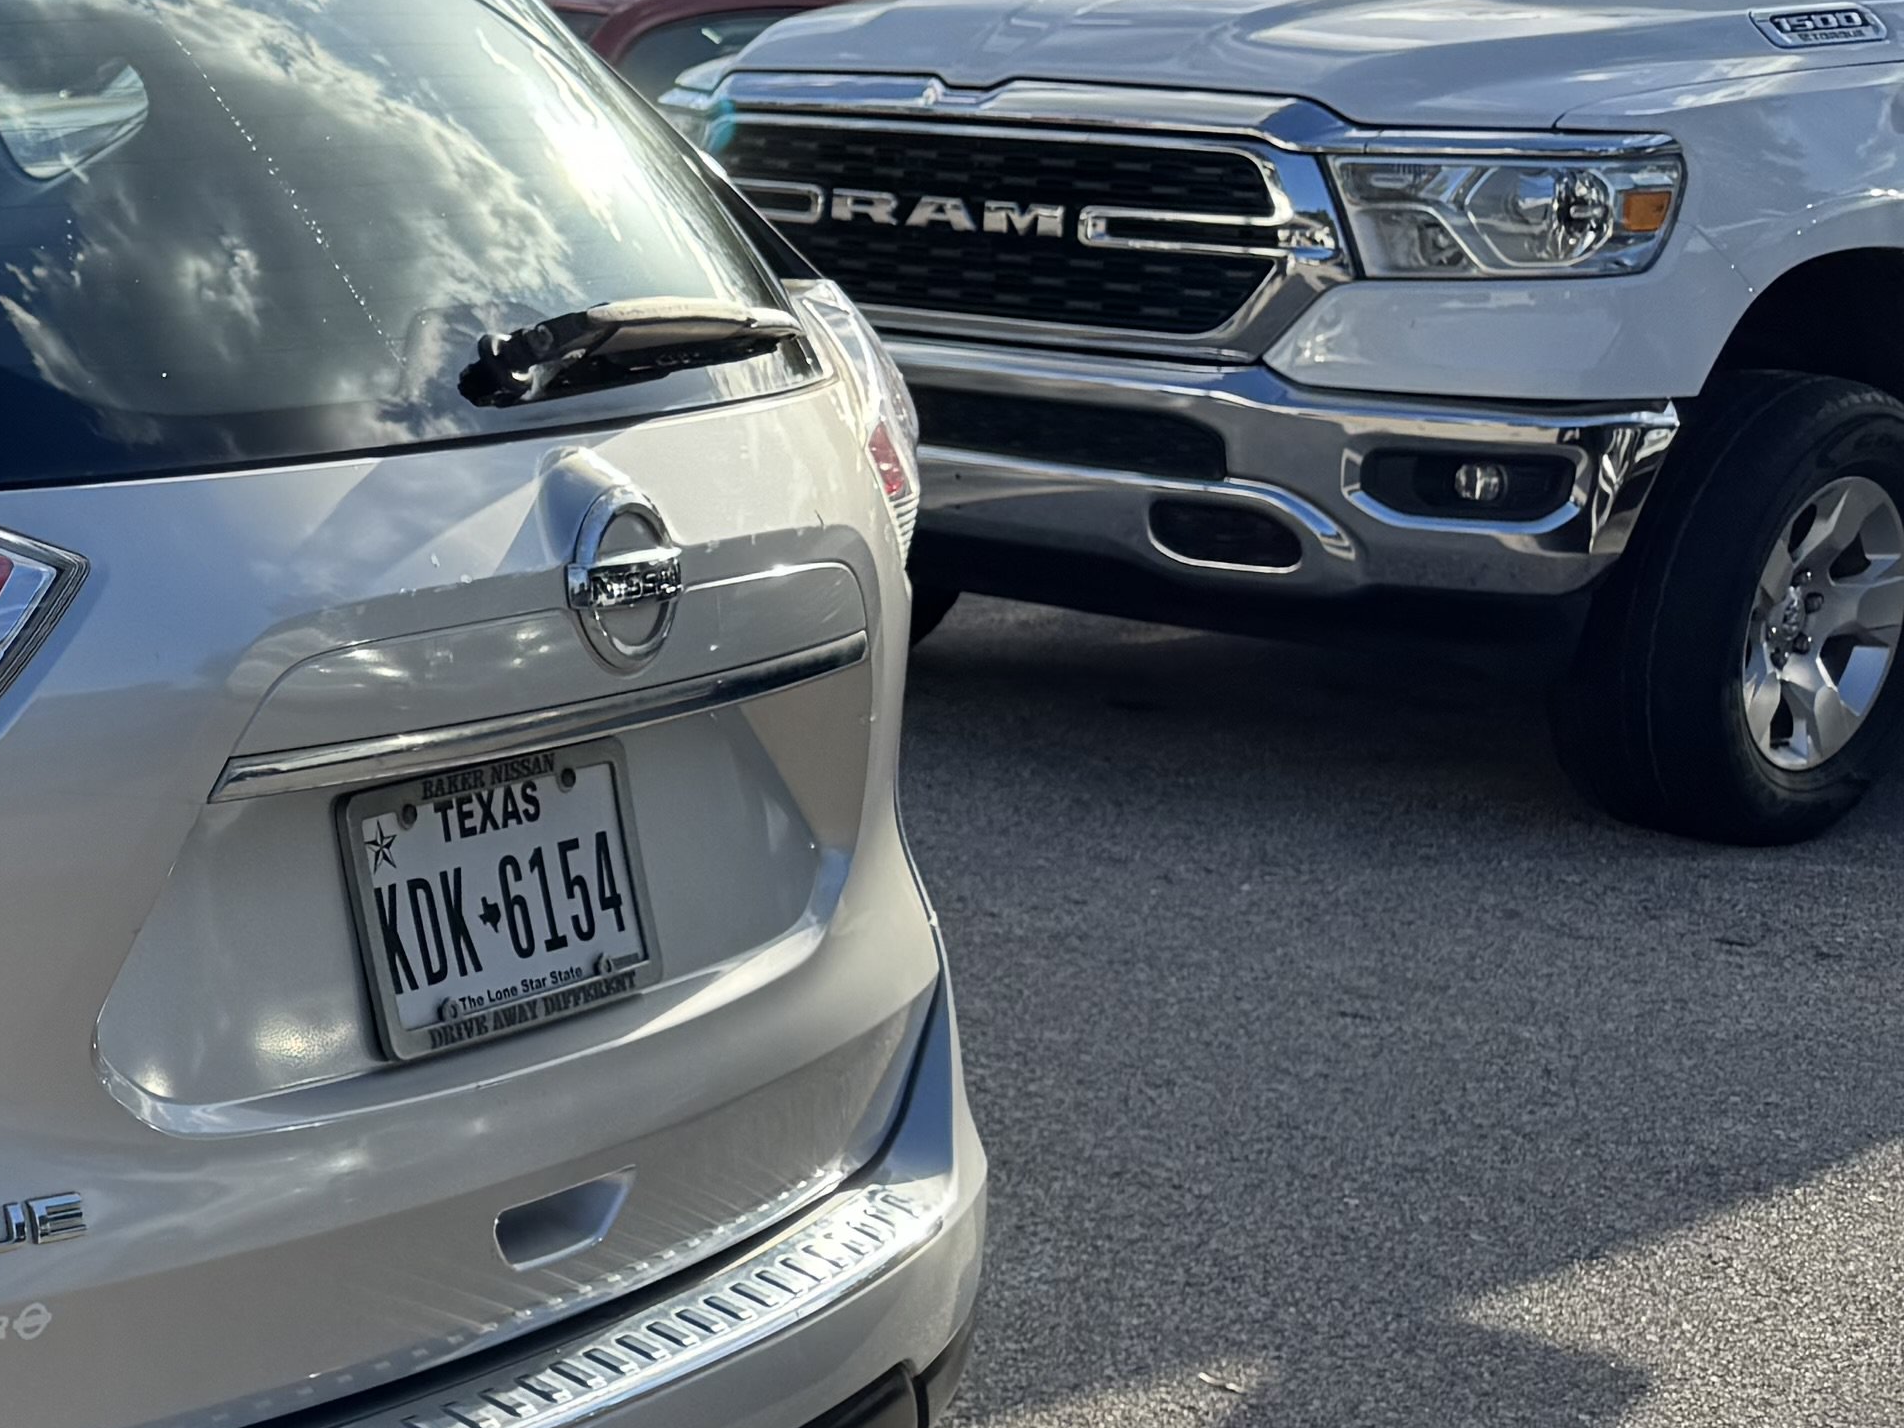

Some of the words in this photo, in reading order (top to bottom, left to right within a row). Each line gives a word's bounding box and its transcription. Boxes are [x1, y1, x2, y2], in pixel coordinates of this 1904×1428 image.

[1774, 12, 1863, 32] 1500
[831, 189, 1065, 238] RAM
[421, 767, 486, 801] BAKER
[492, 752, 556, 786] NISSAN
[433, 780, 540, 842] TEXAS
[428, 1013, 489, 1049] DRIVE
[491, 1002, 539, 1031] AWAY
[542, 972, 638, 1018] DIFFERENT
[458, 993, 485, 1011] The
[487, 986, 518, 1004] Lone
[520, 976, 547, 994] Star
[550, 965, 583, 986] State
